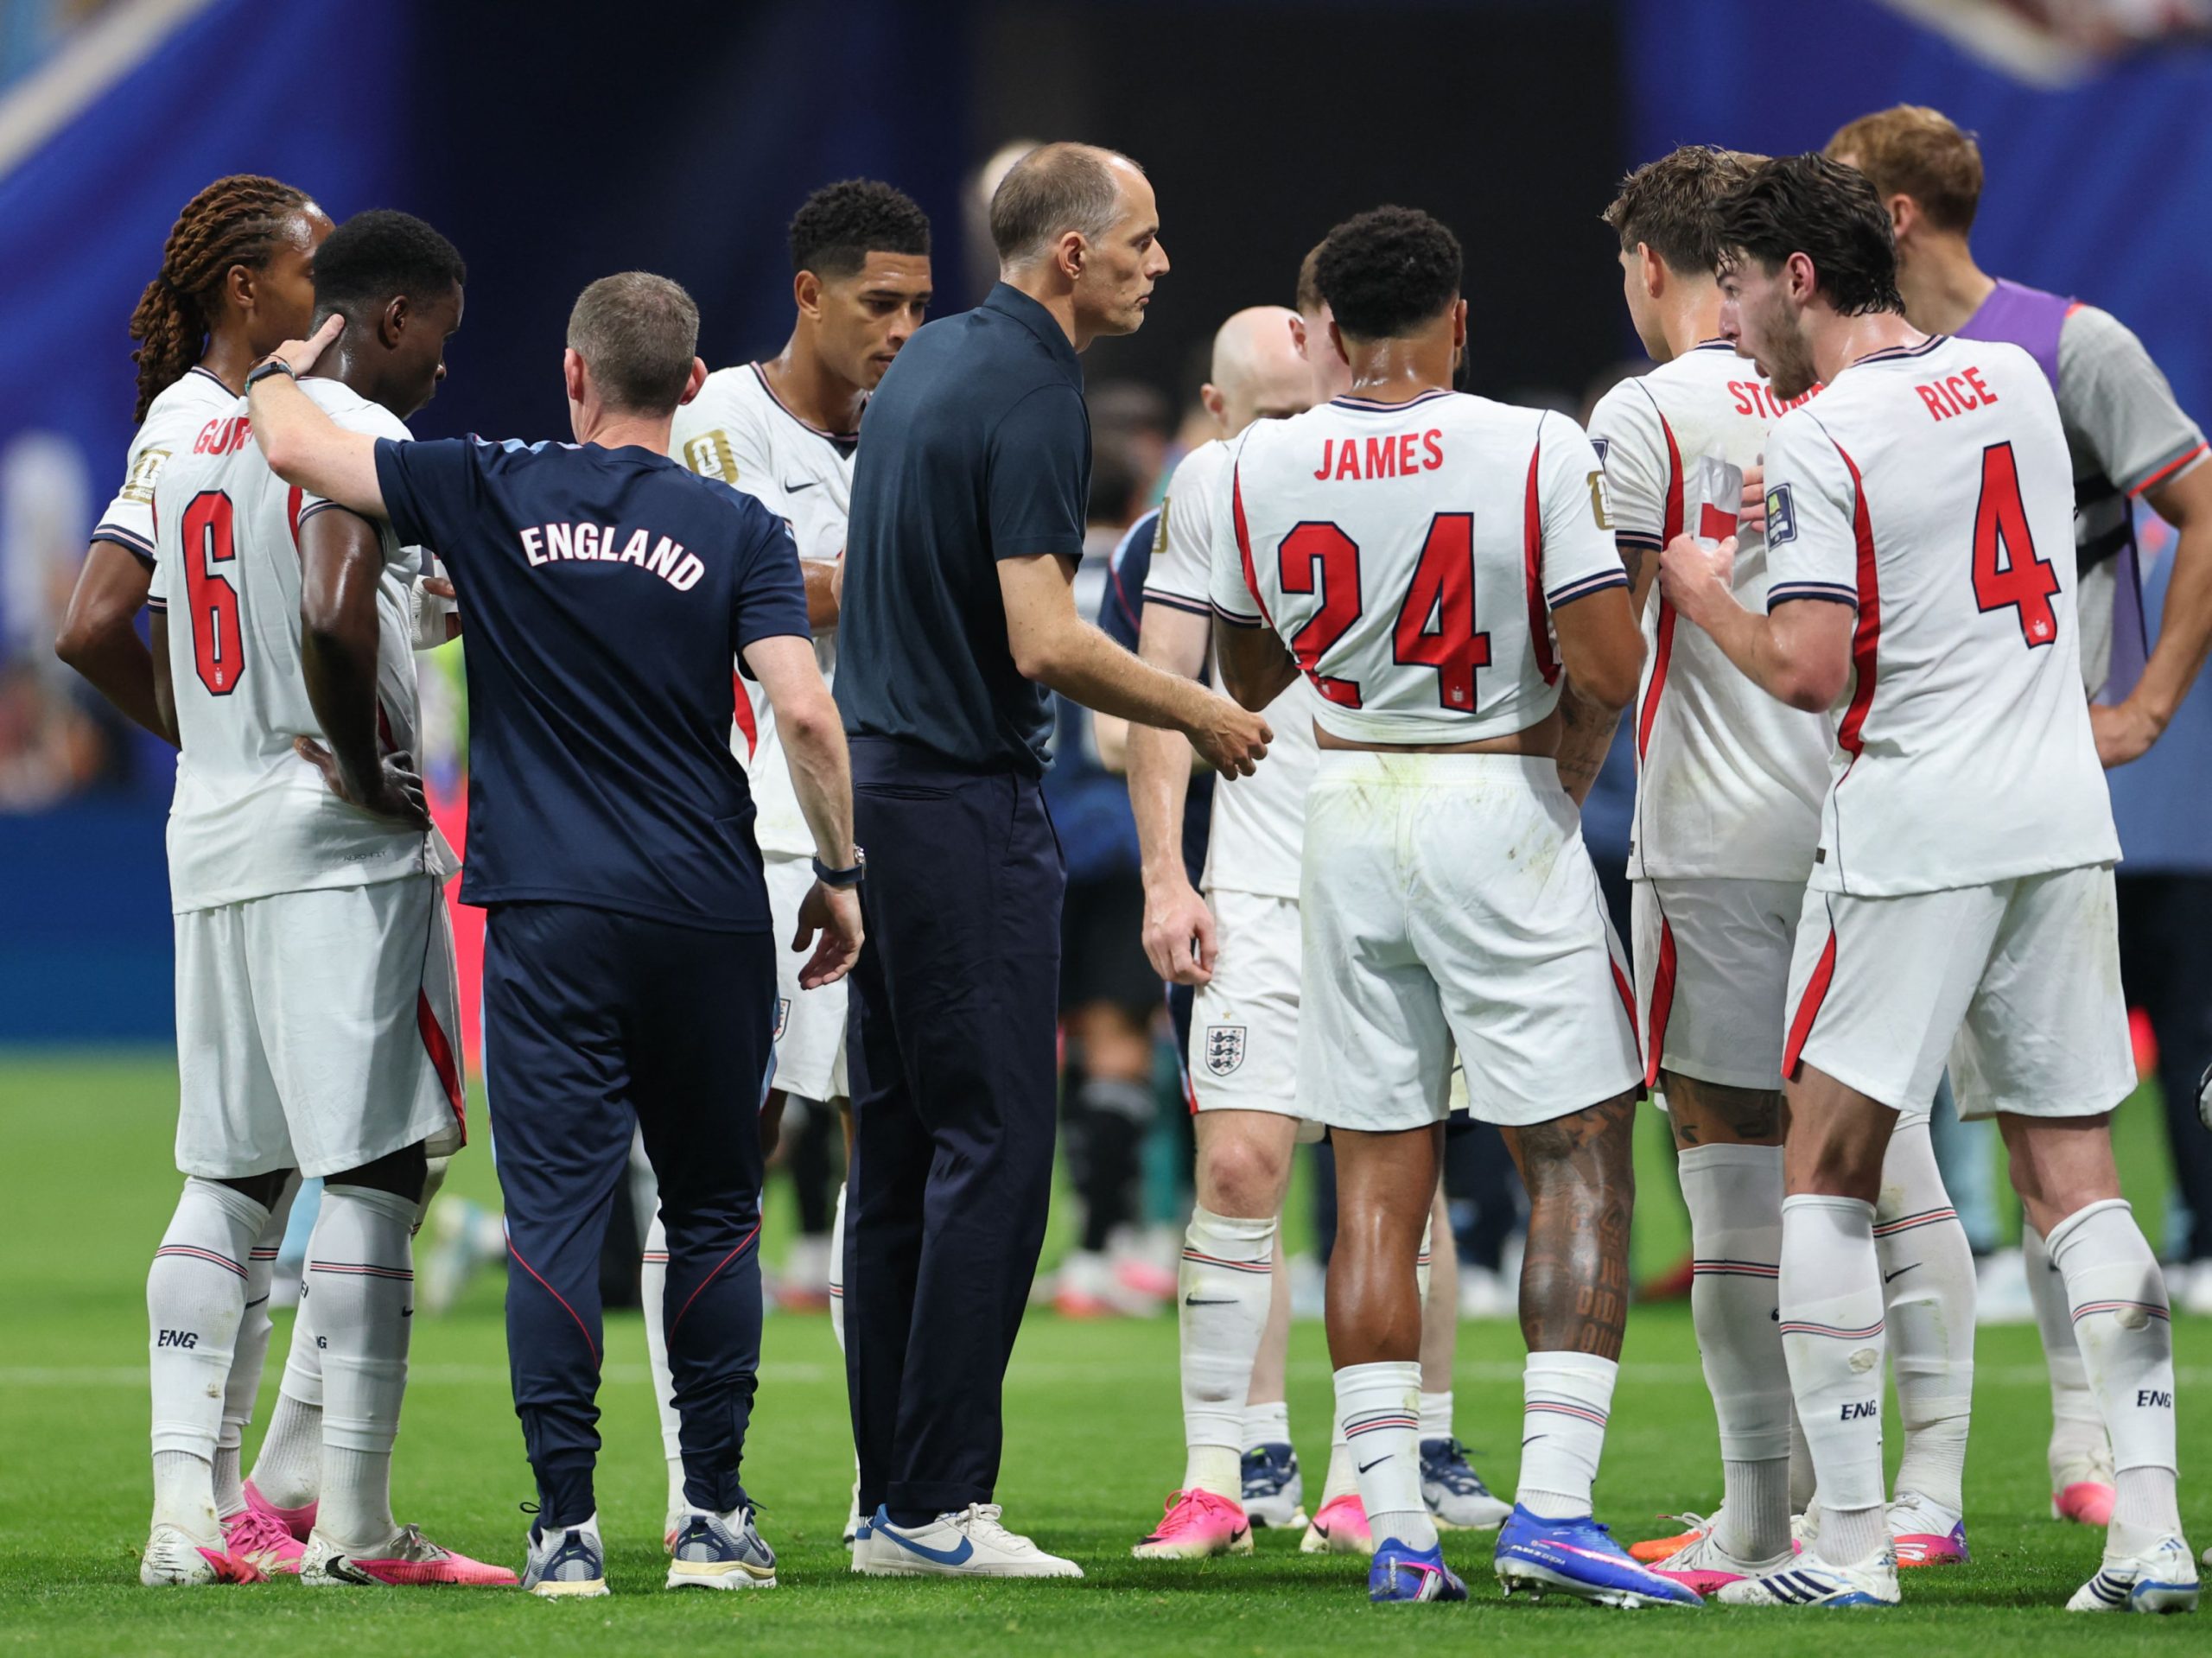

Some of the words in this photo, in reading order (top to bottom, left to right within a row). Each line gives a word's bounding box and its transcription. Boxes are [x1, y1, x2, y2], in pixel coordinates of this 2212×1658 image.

[1727, 380, 1825, 419] STO
[1914, 366, 1999, 422] RICE
[193, 416, 254, 456] GUE
[1313, 429, 1443, 480] JAMES
[519, 522, 705, 592] ENGLAND
[1971, 441, 2062, 650] 4
[181, 489, 245, 696] 6
[1277, 511, 1492, 714] 24
[157, 1329, 199, 1350] ENG
[1840, 1399, 1877, 1420] ENG
[2137, 1389, 2171, 1409] ENG
